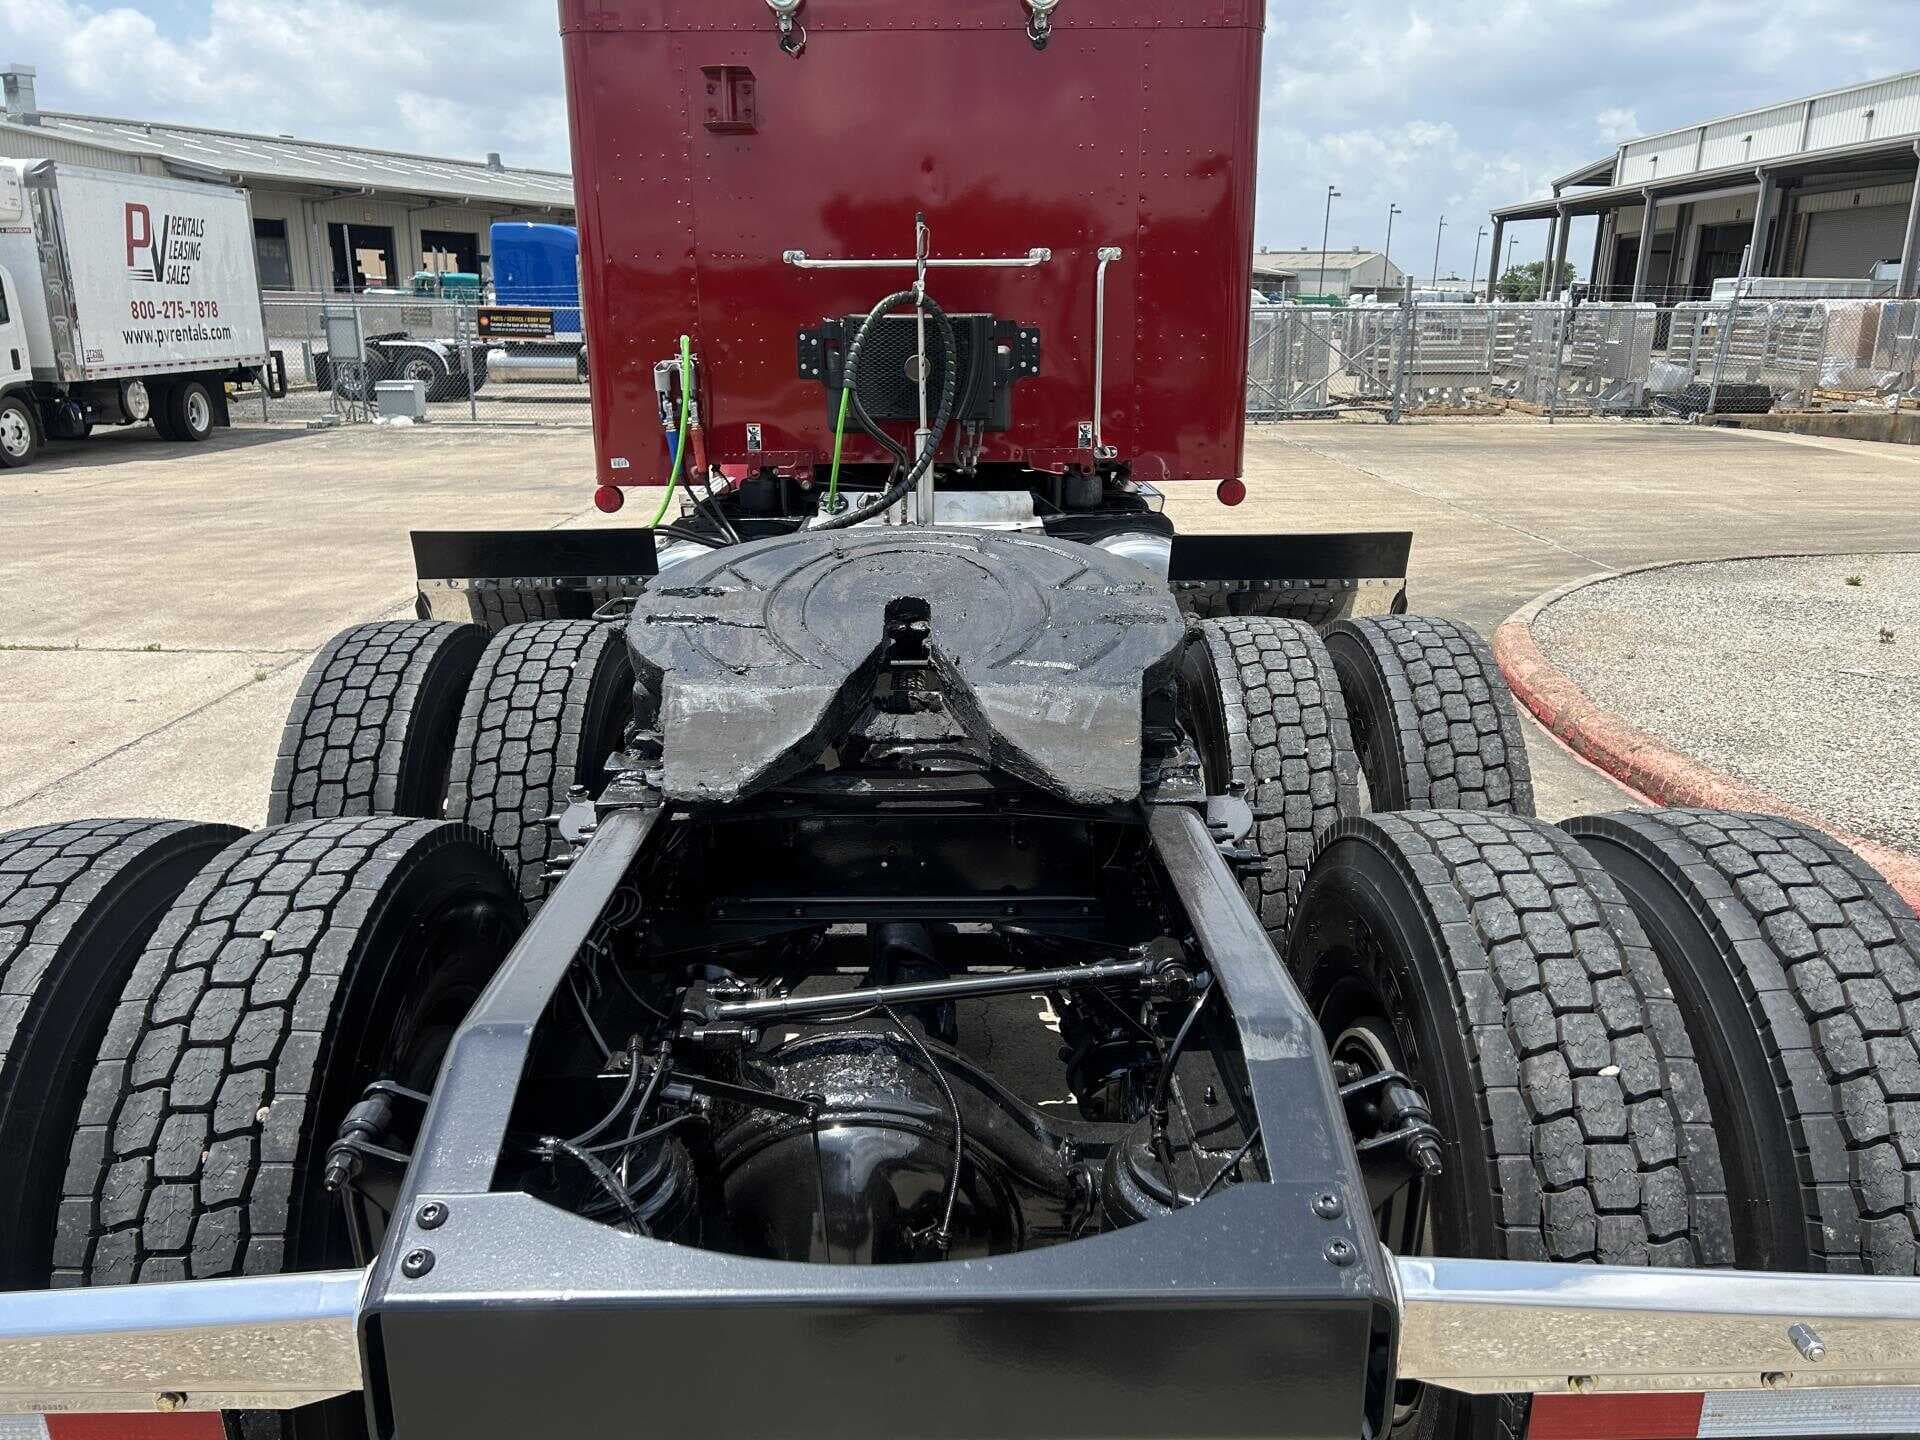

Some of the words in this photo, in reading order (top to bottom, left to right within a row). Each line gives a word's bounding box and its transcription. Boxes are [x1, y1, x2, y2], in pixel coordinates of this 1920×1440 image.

[171, 216, 204, 238] RENTALS
[125, 202, 169, 282] PV
[168, 240, 201, 261] LEASING
[166, 265, 191, 285] SALES
[130, 300, 219, 320] 800-275-7878
[122, 323, 232, 348] www.pvrentals.com
